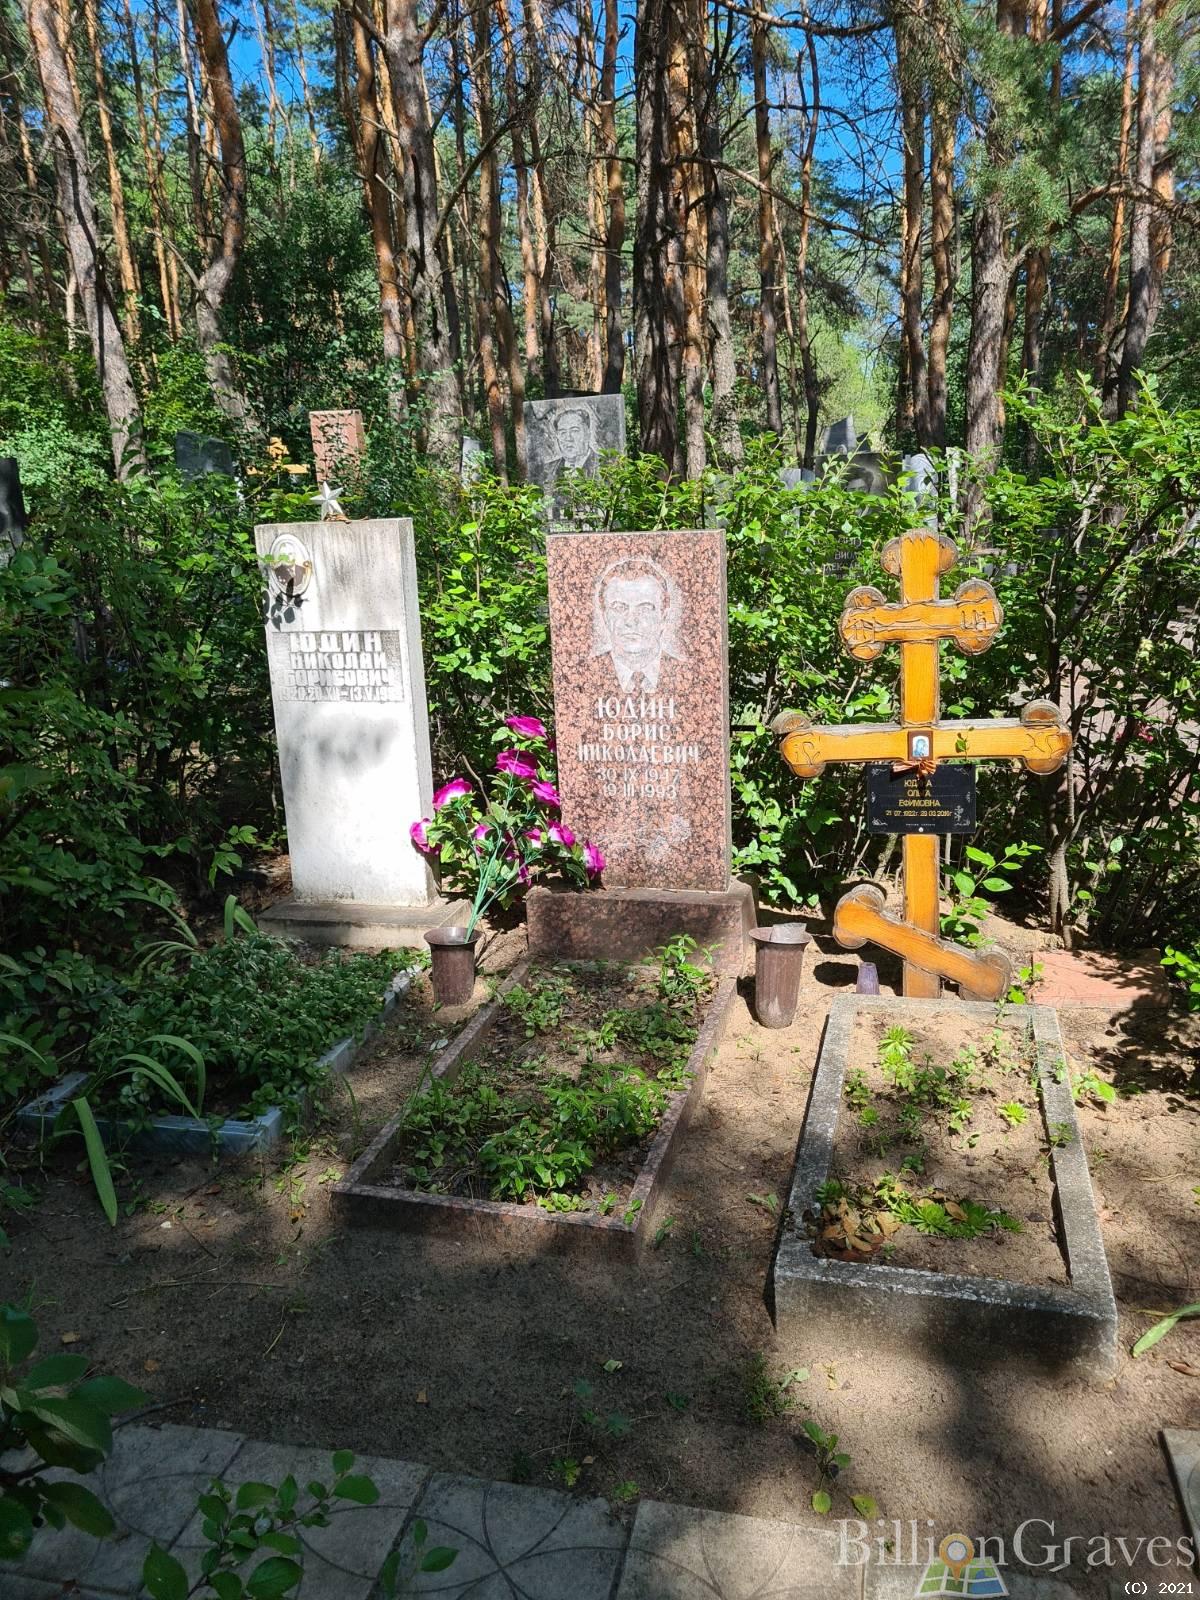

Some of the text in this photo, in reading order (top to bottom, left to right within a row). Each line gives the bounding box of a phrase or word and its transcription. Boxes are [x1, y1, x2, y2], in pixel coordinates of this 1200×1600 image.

[290, 632, 382, 652] ЮДИН
[598, 697, 675, 721] ЮДИН
[602, 723, 671, 741] БОРИС
[578, 744, 700, 764] НИКОЛАЕВИЧ
[904, 780, 933, 788] ЮДА
